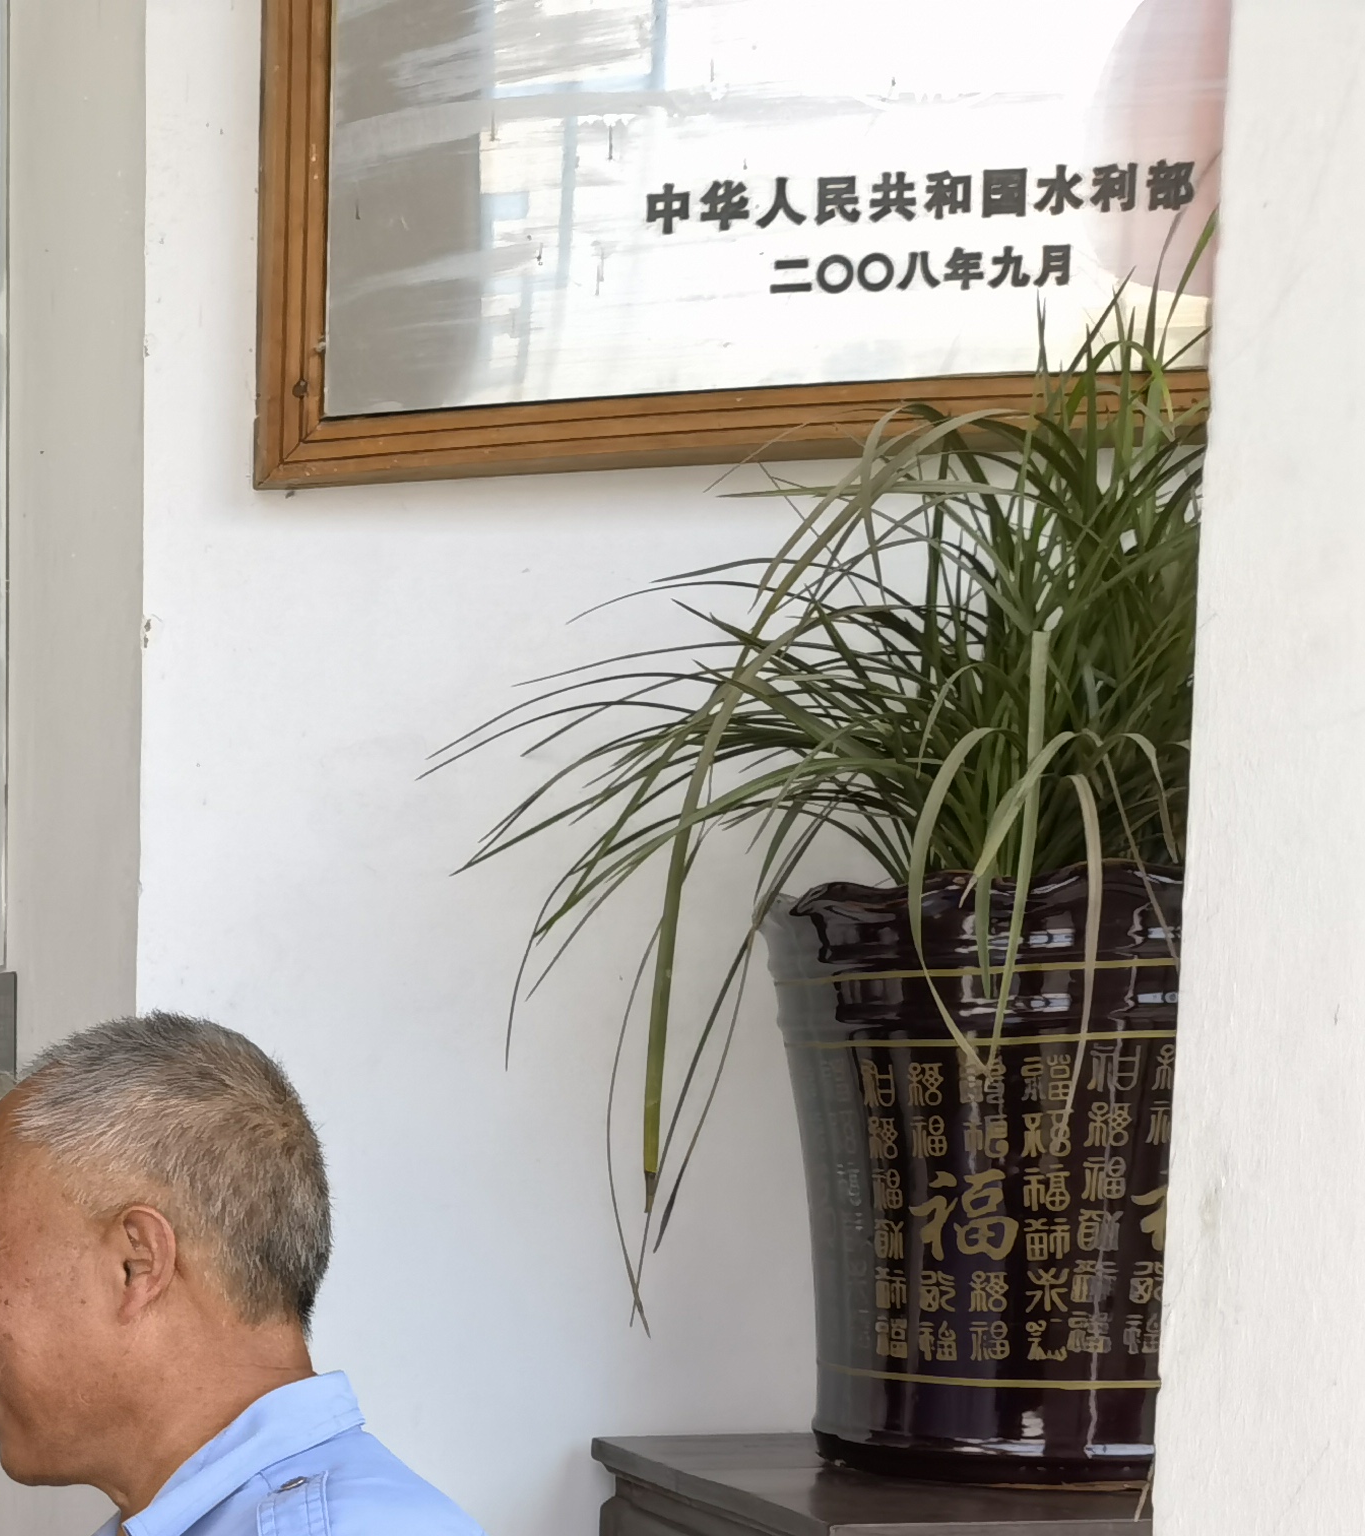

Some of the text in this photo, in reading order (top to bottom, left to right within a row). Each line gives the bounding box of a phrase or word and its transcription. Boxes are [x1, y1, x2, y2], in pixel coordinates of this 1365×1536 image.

[646, 158, 1196, 235] 中华人民共和国水利部
[769, 244, 1072, 295] 二〇〇八年九月
[908, 1168, 1019, 1261] 福
